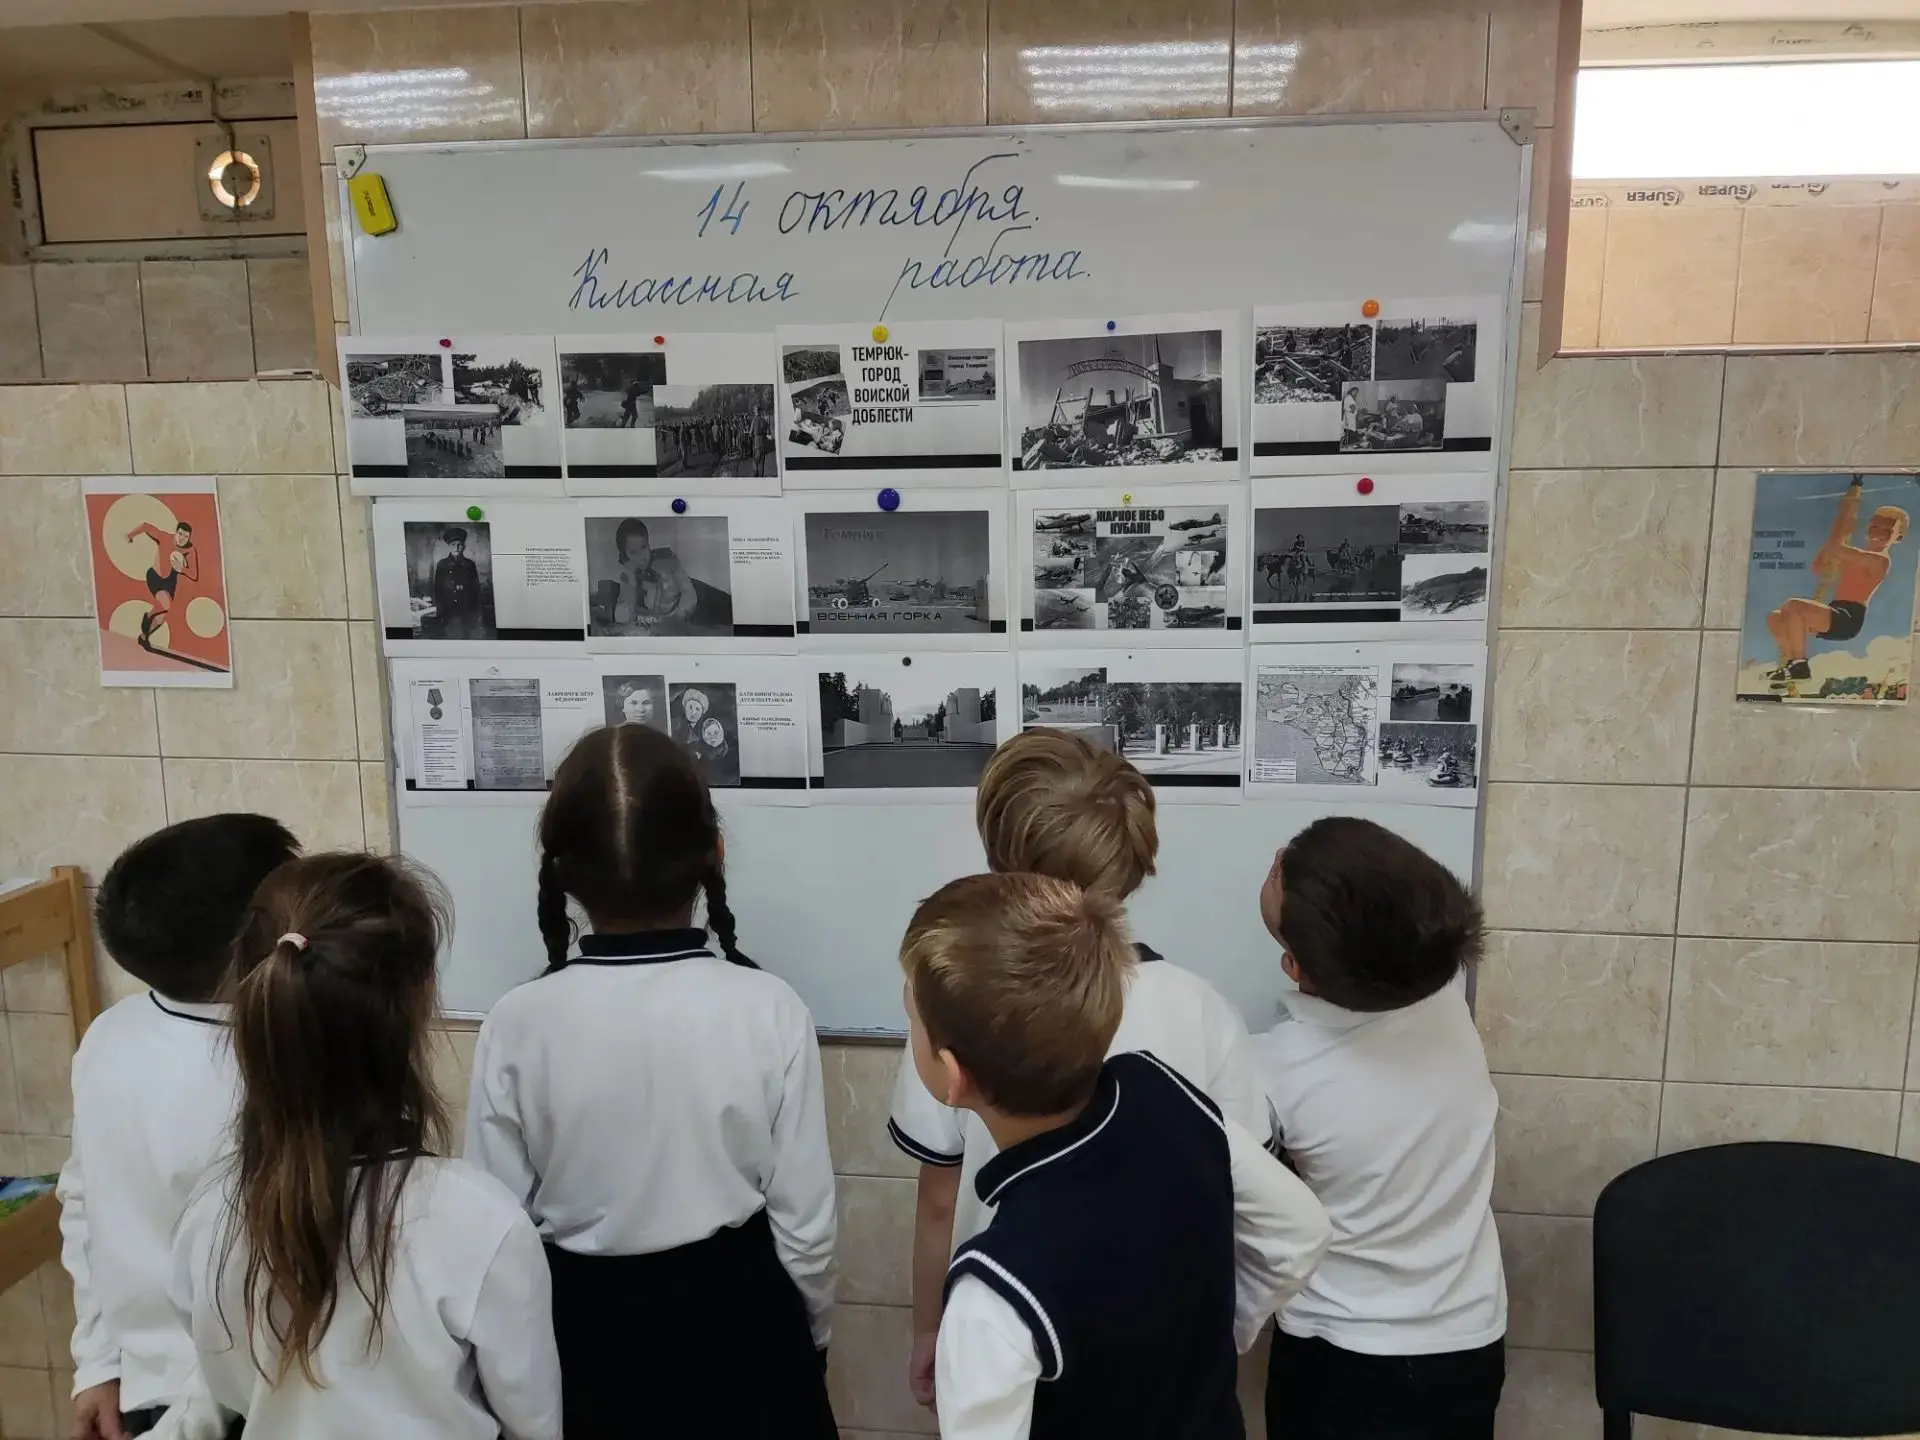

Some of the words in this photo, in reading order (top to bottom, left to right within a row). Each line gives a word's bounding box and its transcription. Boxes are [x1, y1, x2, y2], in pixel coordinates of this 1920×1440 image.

[696, 179, 751, 238] 14
[777, 152, 1042, 257] октября.
[1626, 191, 1676, 202] SUPER
[567, 247, 800, 311] Классная
[878, 224, 1092, 322] работа.
[851, 345, 910, 361] ТЕМРЮК-
[862, 366, 902, 384] ГОРОД
[854, 383, 910, 403] ВОИСКОЙ
[851, 407, 913, 426] ДОБЛЕСТИ
[1110, 521, 1151, 535] КУБАНИ
[817, 612, 887, 621] ВОЕННАЯ
[893, 612, 943, 621] ГОРКА
